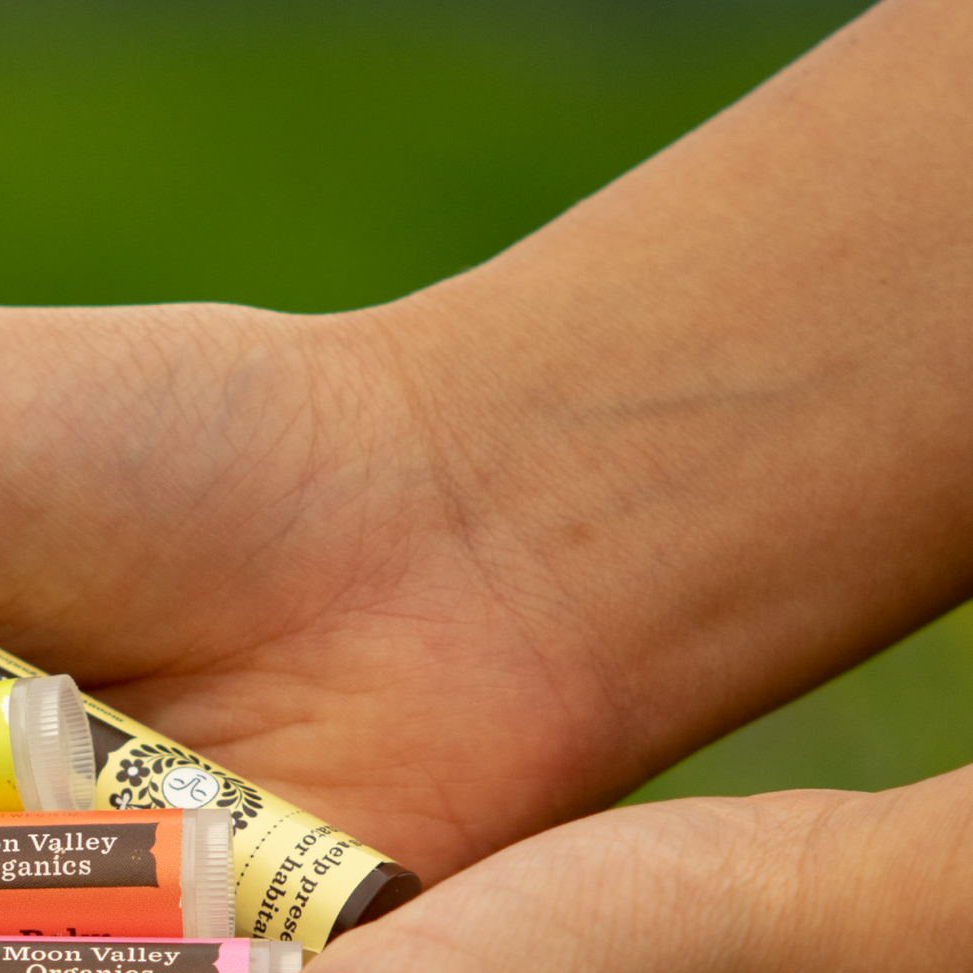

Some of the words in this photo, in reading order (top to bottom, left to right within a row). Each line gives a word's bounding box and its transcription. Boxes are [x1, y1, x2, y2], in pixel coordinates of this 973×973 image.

[28, 832, 118, 855] Valley
[252, 856, 303, 938] habita
[2, 946, 83, 962] Moon
[89, 947, 181, 966] Valley
